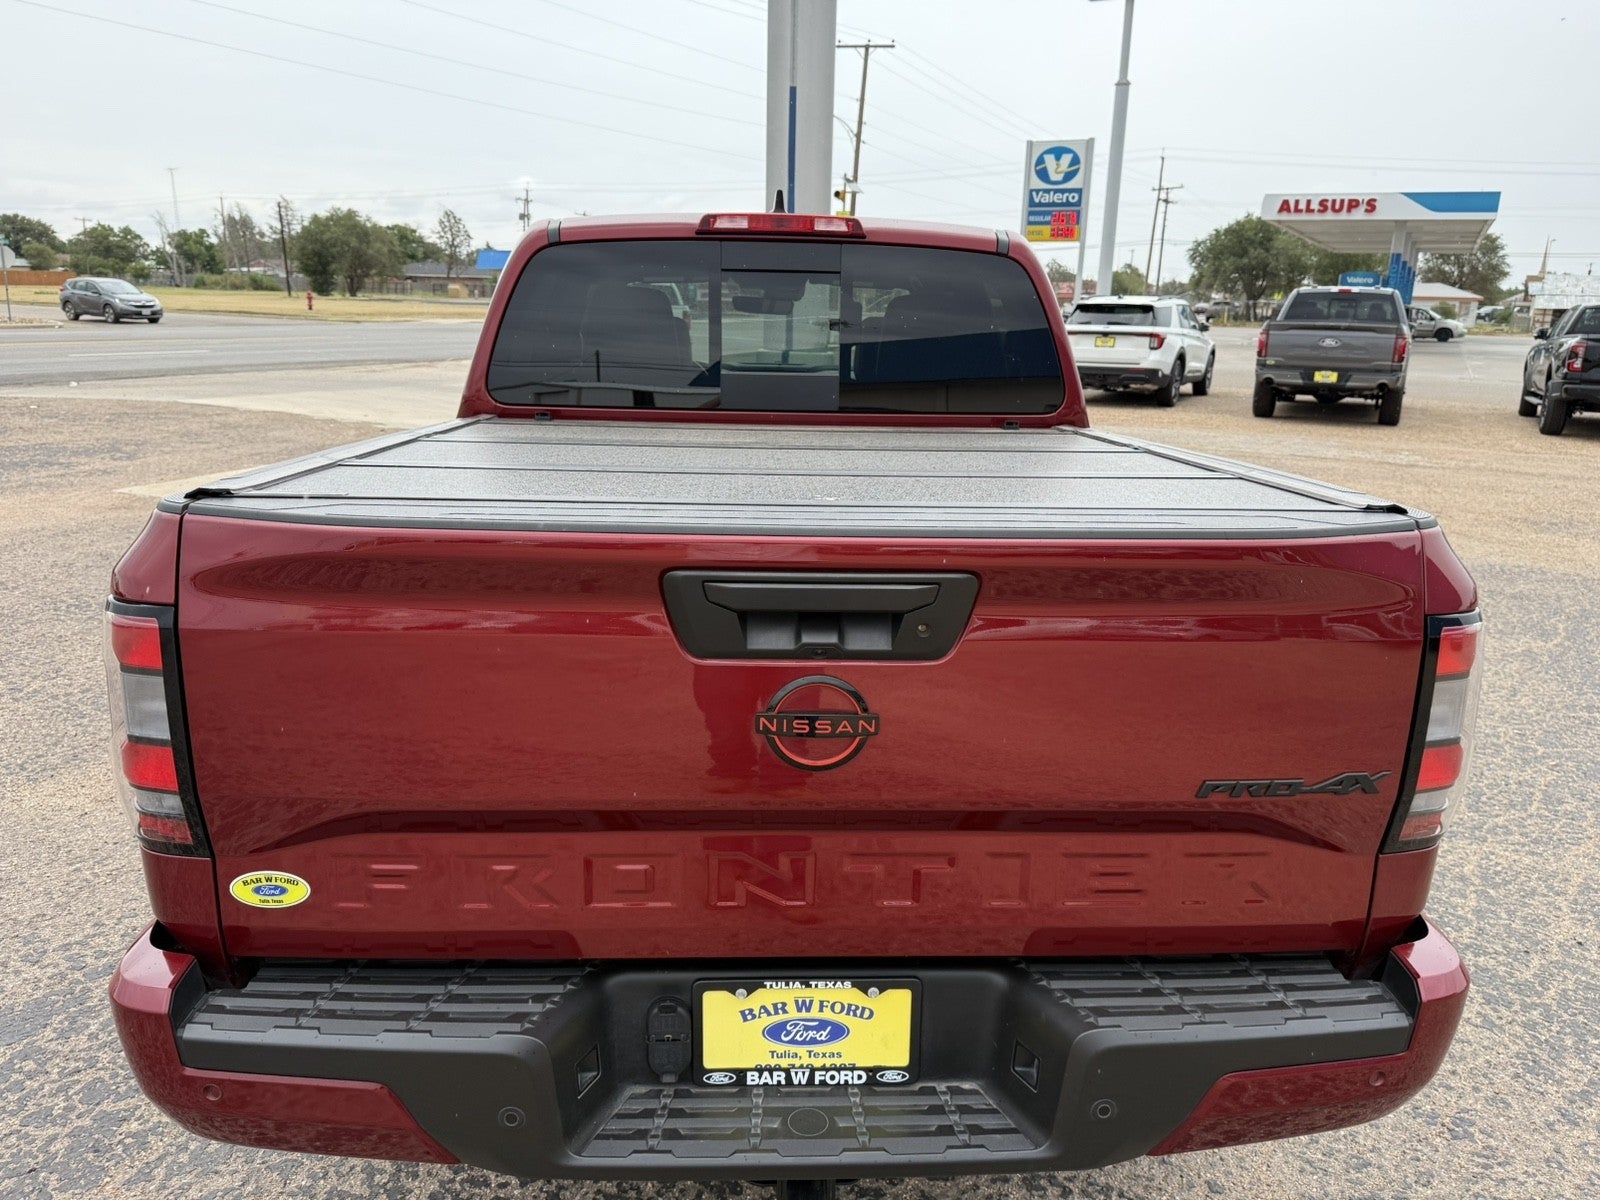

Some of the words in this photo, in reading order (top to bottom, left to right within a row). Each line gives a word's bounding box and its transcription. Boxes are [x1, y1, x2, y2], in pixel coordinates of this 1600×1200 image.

[1031, 191, 1079, 203] Valero
[1277, 198, 1378, 214] ALLSUP'S
[1346, 276, 1374, 284] Valero
[759, 717, 876, 734] NISSAN
[242, 877, 262, 887] BAR
[264, 874, 273, 883] W
[274, 876, 299, 887] FORD
[328, 851, 1278, 910] FRONTIER
[259, 885, 281, 895] Ford
[809, 981, 853, 989] TEXAS
[738, 1001, 788, 1023] BAR
[793, 996, 815, 1014] W
[818, 1000, 875, 1021] FORD
[780, 1020, 832, 1042] Ford
[768, 1050, 802, 1061] Tulia,
[806, 1050, 843, 1060] Texas
[709, 1073, 730, 1082] Ford
[746, 1070, 786, 1085] BAR
[789, 1068, 811, 1085] W
[814, 1070, 868, 1085] FORD
[882, 1071, 903, 1081] Ford
